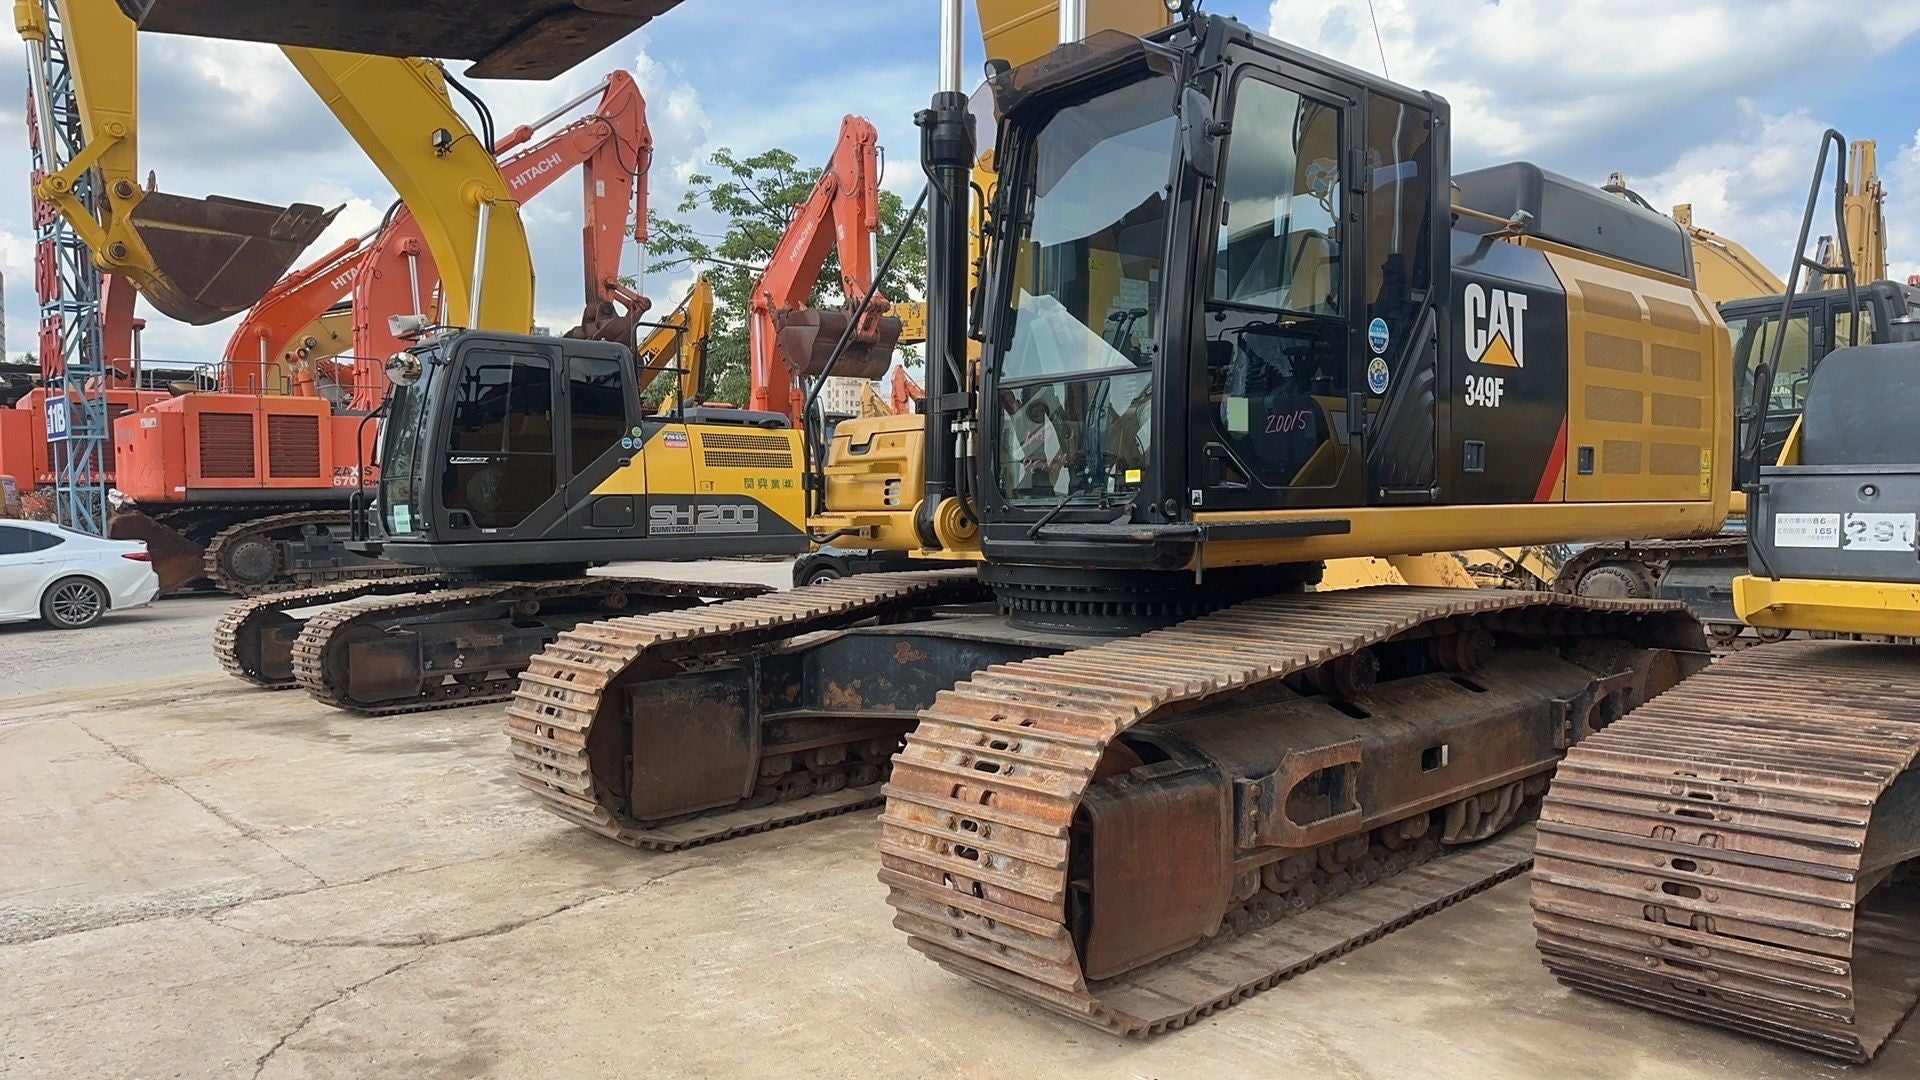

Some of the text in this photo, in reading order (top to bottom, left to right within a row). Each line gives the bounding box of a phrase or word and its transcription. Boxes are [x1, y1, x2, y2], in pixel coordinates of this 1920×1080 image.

[510, 152, 562, 189] HITACHI
[330, 267, 358, 290] HITA
[1464, 283, 1528, 368] CAT
[1465, 375, 1504, 407] 349F
[48, 403, 66, 433] 11B
[1265, 410, 1312, 434] 20015
[333, 464, 373, 477] ZAXS
[333, 476, 358, 486] 670
[650, 525, 694, 533] SUMITOMO
